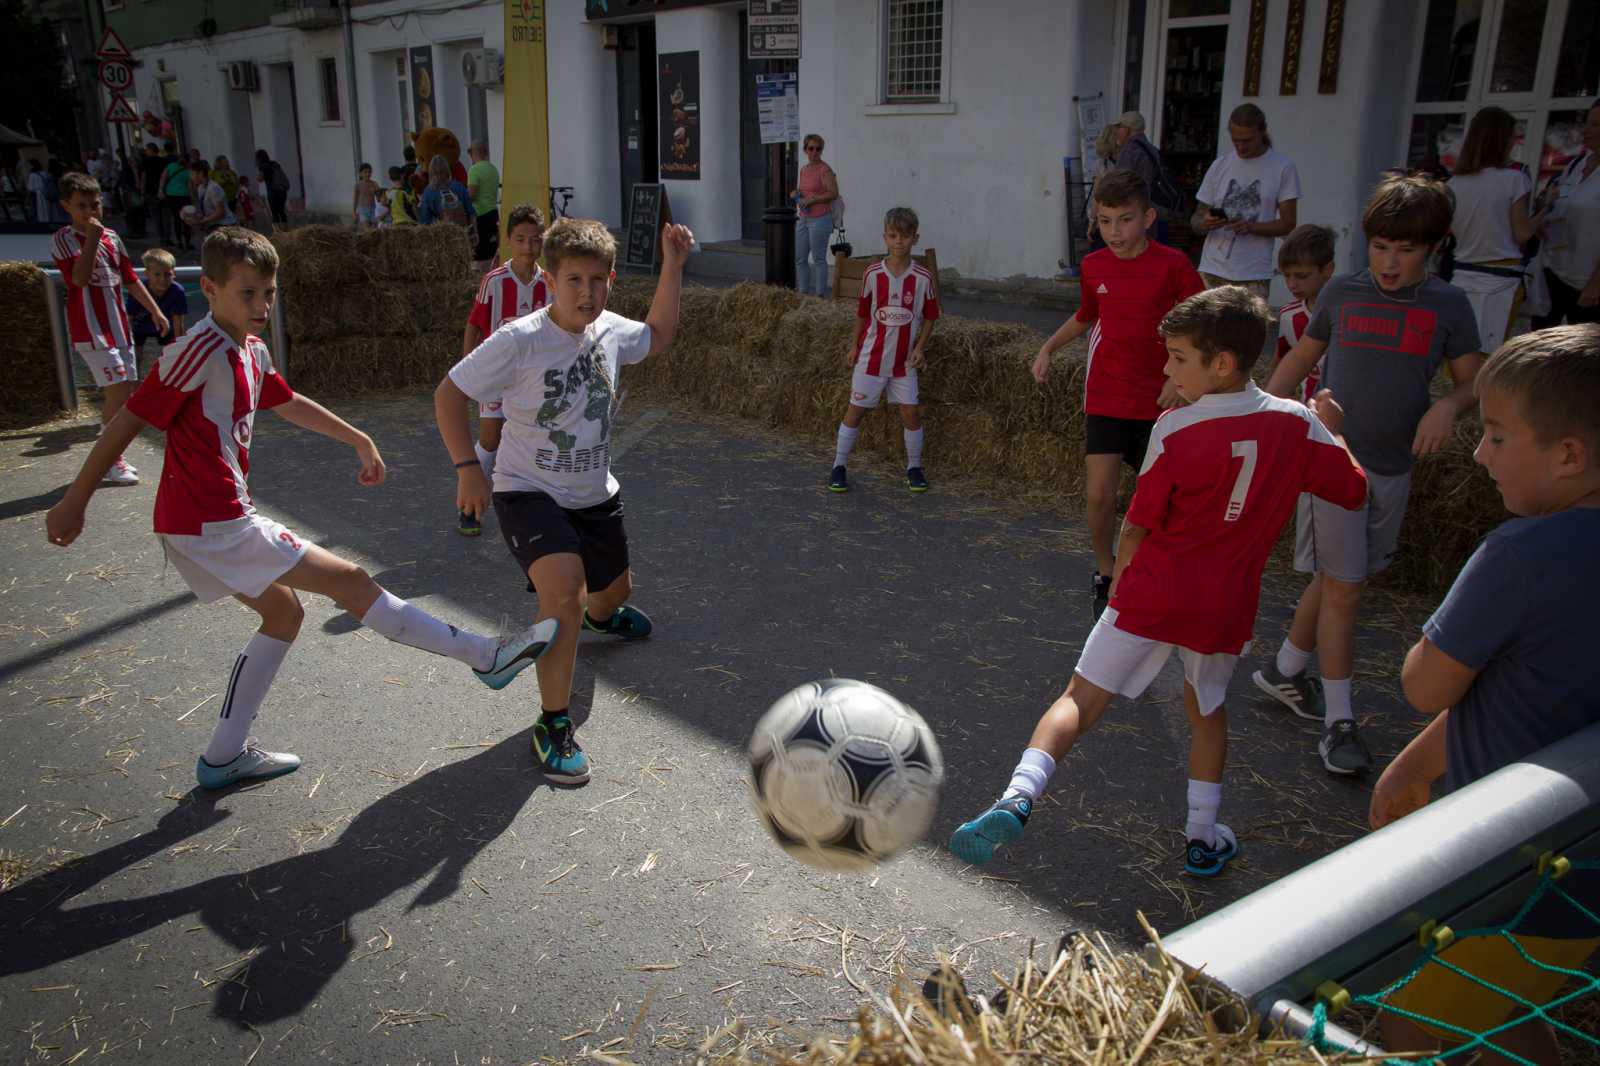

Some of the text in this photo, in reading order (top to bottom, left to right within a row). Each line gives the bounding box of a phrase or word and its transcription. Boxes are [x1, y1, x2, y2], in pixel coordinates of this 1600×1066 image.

[106, 65, 127, 84] 30
[103, 366, 113, 382] 5
[1223, 439, 1258, 521] 7
